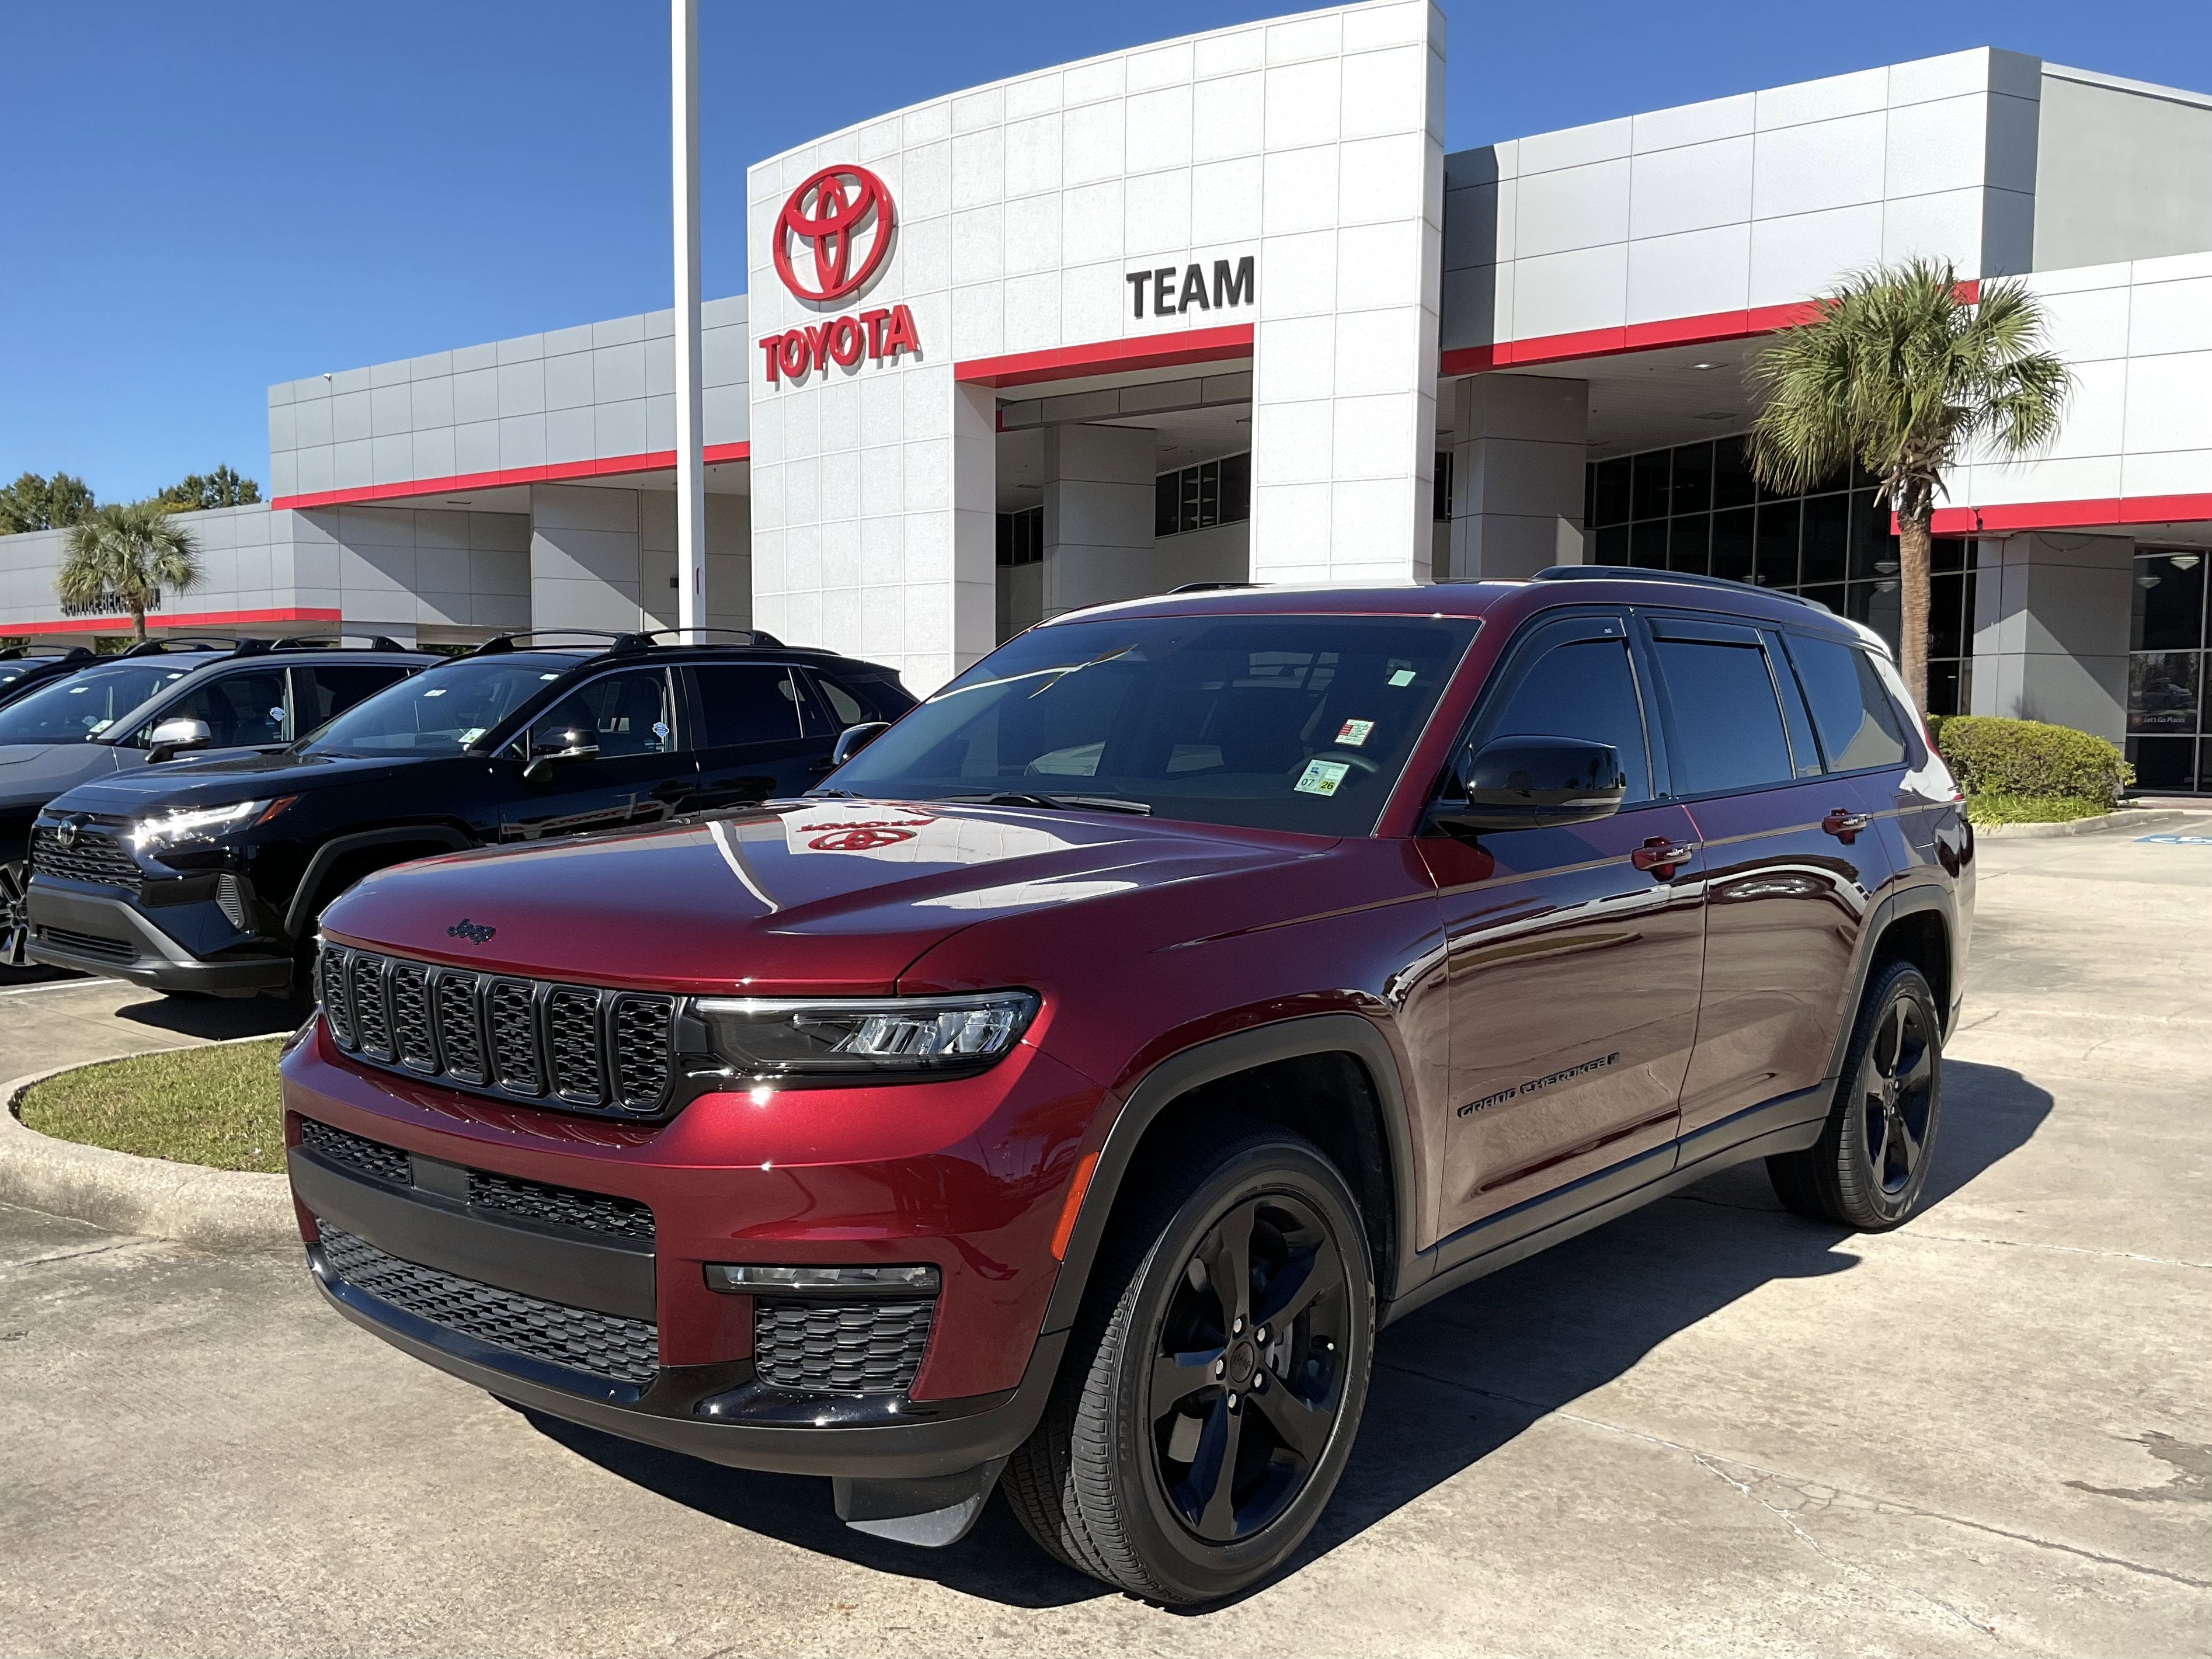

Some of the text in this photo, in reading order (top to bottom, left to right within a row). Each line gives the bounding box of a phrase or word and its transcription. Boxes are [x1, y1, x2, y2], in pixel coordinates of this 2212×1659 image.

[1126, 255, 1254, 318] TEAM
[760, 304, 919, 381] TOYOTA
[1301, 778, 1334, 789] 07 26
[447, 918, 496, 945] Jeep
[1457, 1057, 1605, 1118] GRAND CHEROKEE
